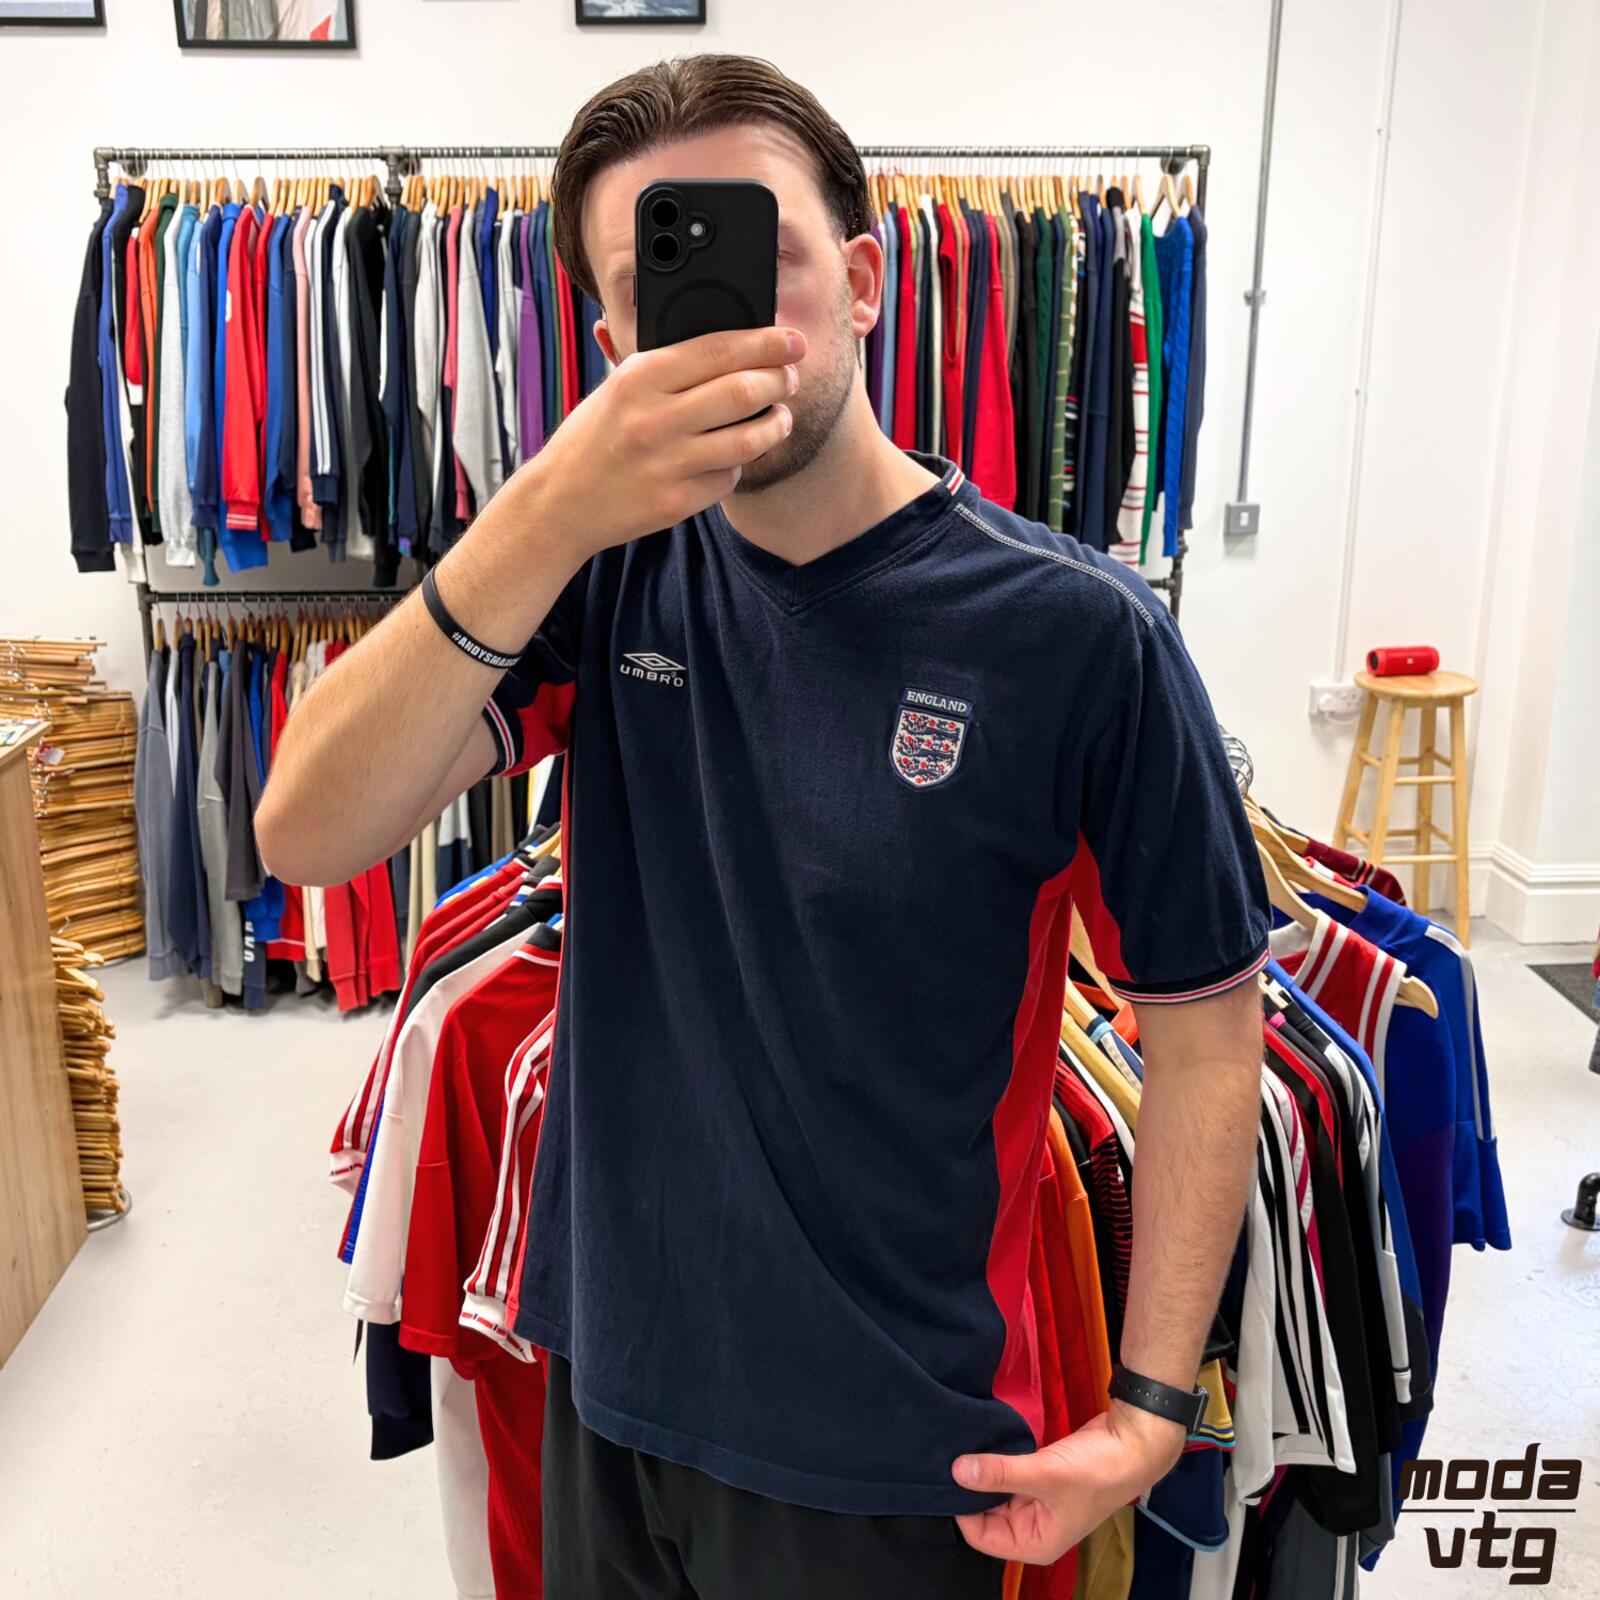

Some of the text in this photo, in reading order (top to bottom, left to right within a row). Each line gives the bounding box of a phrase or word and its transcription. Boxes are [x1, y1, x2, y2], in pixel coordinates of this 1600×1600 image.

[451, 631, 521, 667] #ANDYSMA
[619, 663, 684, 687] UMBRO
[906, 690, 967, 712] ENGLAND
